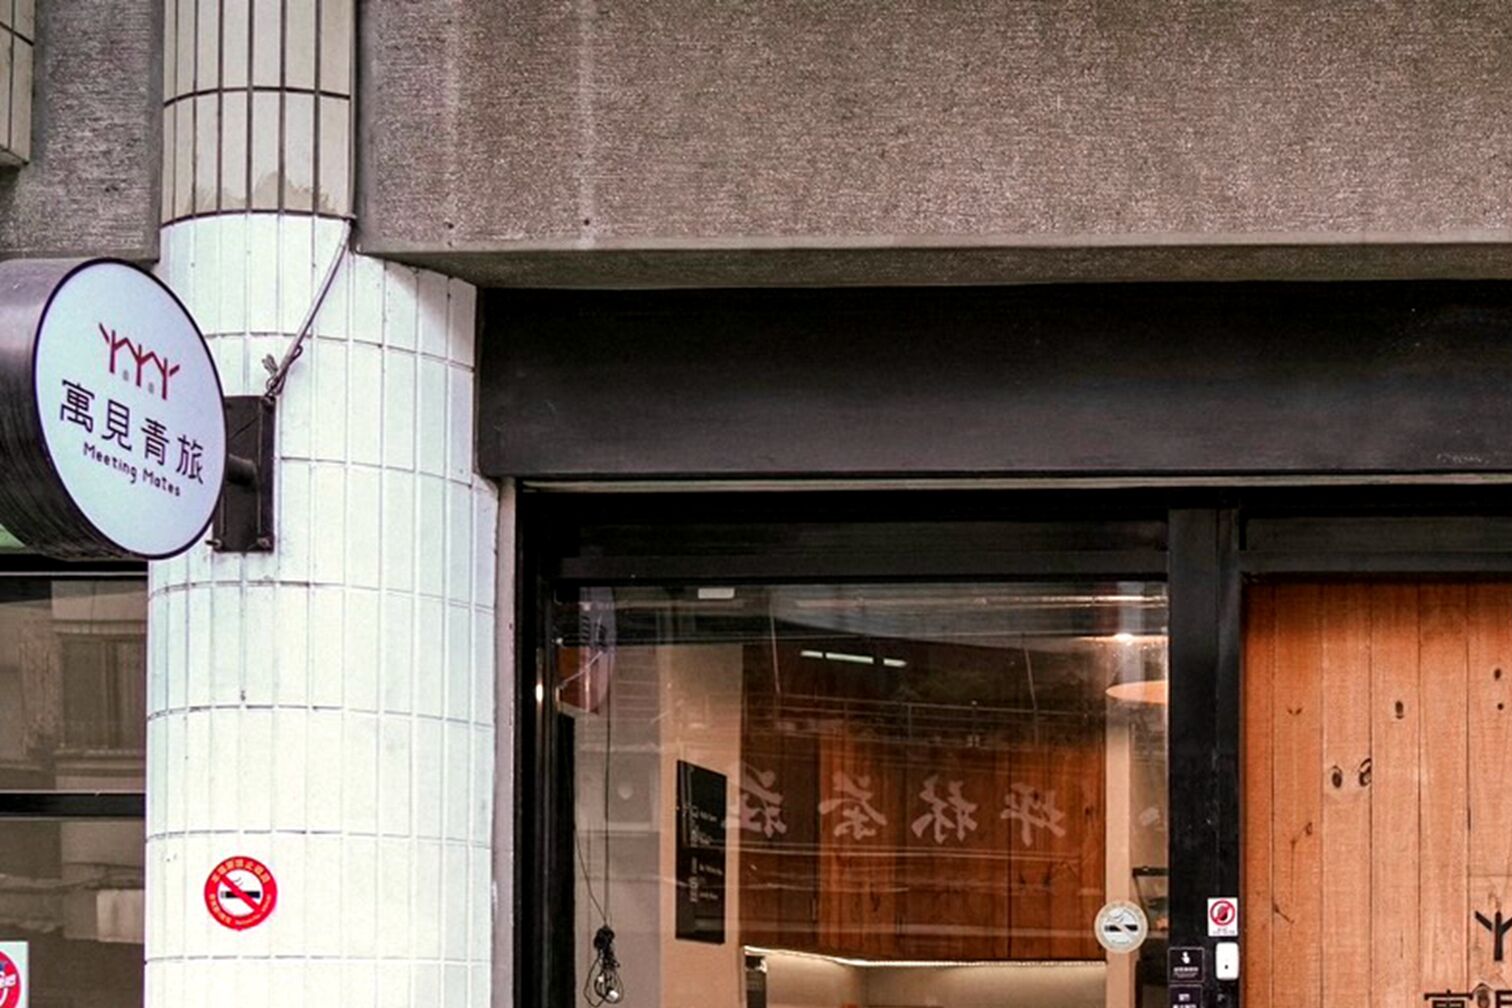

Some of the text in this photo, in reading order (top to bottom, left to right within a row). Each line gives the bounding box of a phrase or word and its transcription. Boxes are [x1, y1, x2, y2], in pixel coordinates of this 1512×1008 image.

[60, 378, 205, 485] 寓見青旅
[83, 442, 182, 497] Meeting Mates
